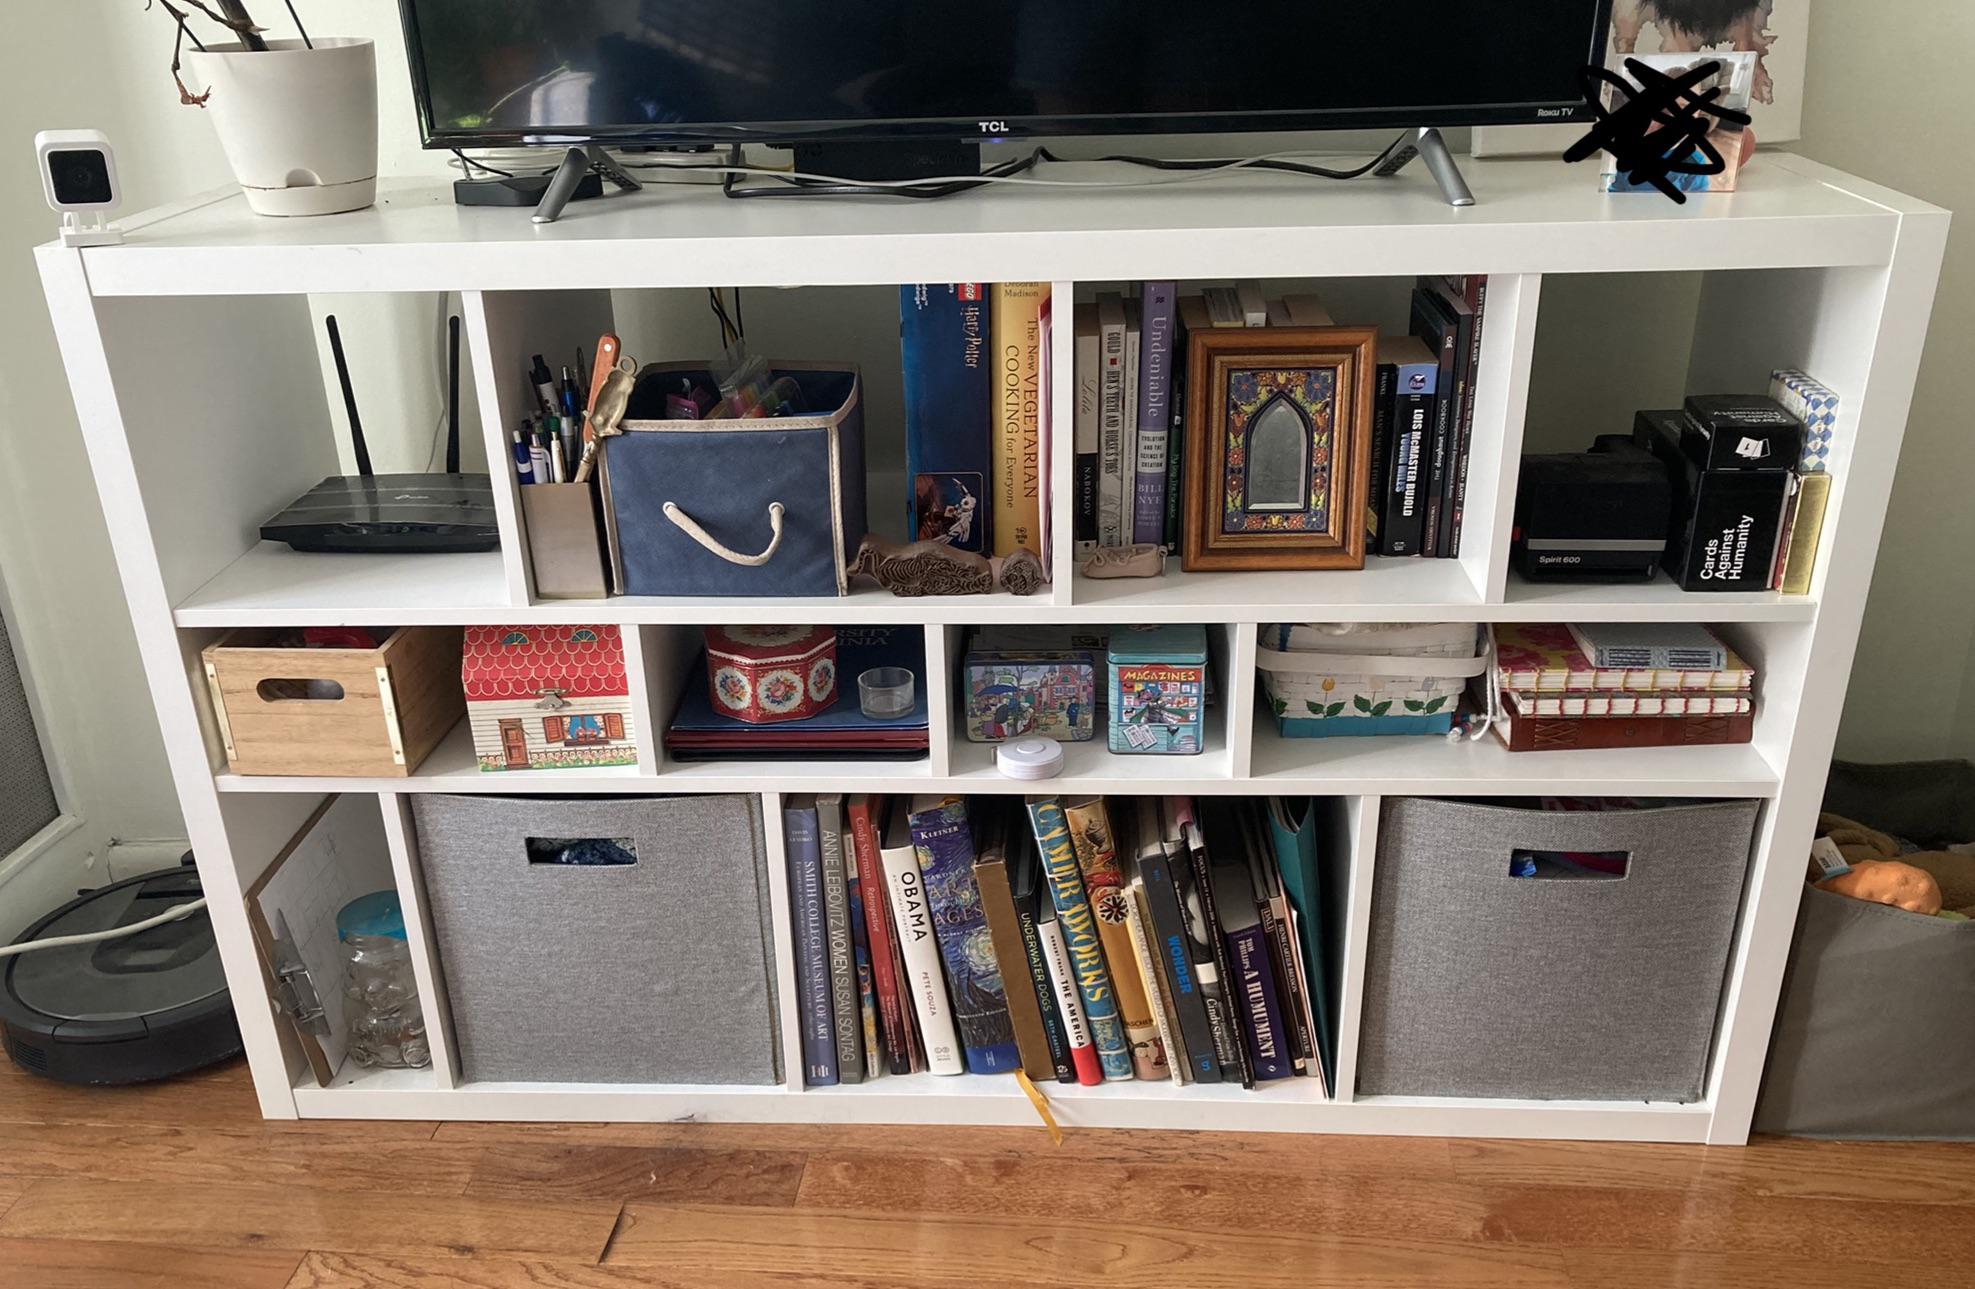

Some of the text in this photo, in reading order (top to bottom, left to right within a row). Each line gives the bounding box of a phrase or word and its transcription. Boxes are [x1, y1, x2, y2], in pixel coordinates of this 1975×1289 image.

[978, 121, 1009, 132] TCL
[1561, 107, 1574, 116] TV
[965, 283, 976, 300] EGO
[1004, 289, 1039, 298] Madison
[961, 305, 982, 368] Harry Potter
[1148, 317, 1168, 417] Undeniable
[1024, 320, 1039, 498] The New VEGETARIAN
[1104, 415, 1119, 428] AND
[1105, 392, 1120, 413] TEETH
[1412, 409, 1424, 430] LOIS
[1438, 399, 1447, 434] COOKBOOK
[1004, 345, 1020, 509] COOKING for Everyone
[1395, 432, 1411, 492] YOUNG MILES
[1407, 431, 1422, 482] McMASTER
[1083, 466, 1092, 515] NABOKOV
[1403, 483, 1416, 516] BUJOLD
[1539, 555, 1581, 565] Spirit 600
[1700, 539, 1719, 580] Cards
[1714, 528, 1735, 580] Against
[1728, 515, 1754, 580] Humanity
[1124, 670, 1195, 681] MAGAZINES
[855, 816, 880, 932] Cindy Sherman Retrospective
[901, 871, 928, 943] OBAMA
[934, 905, 985, 926] AGES
[804, 860, 829, 1040] SMITH COLLEGE MUSEUM OF ART
[822, 830, 856, 1062] ANNIE LEIBOVITZ WOMEN SUSAN SONTAG
[1238, 939, 1251, 970] PHILLIPS
[1246, 938, 1255, 952] TOM
[1277, 922, 1287, 943] HENRI
[1020, 912, 1053, 1012] UNDERWATER DOGS
[1167, 935, 1193, 994] WONDER
[922, 971, 937, 1017] PETE SOUZA
[1061, 979, 1085, 1048] THE AMERICA
[1206, 998, 1221, 1027] Cindy
[1243, 970, 1276, 1059] A HUMUMENT
